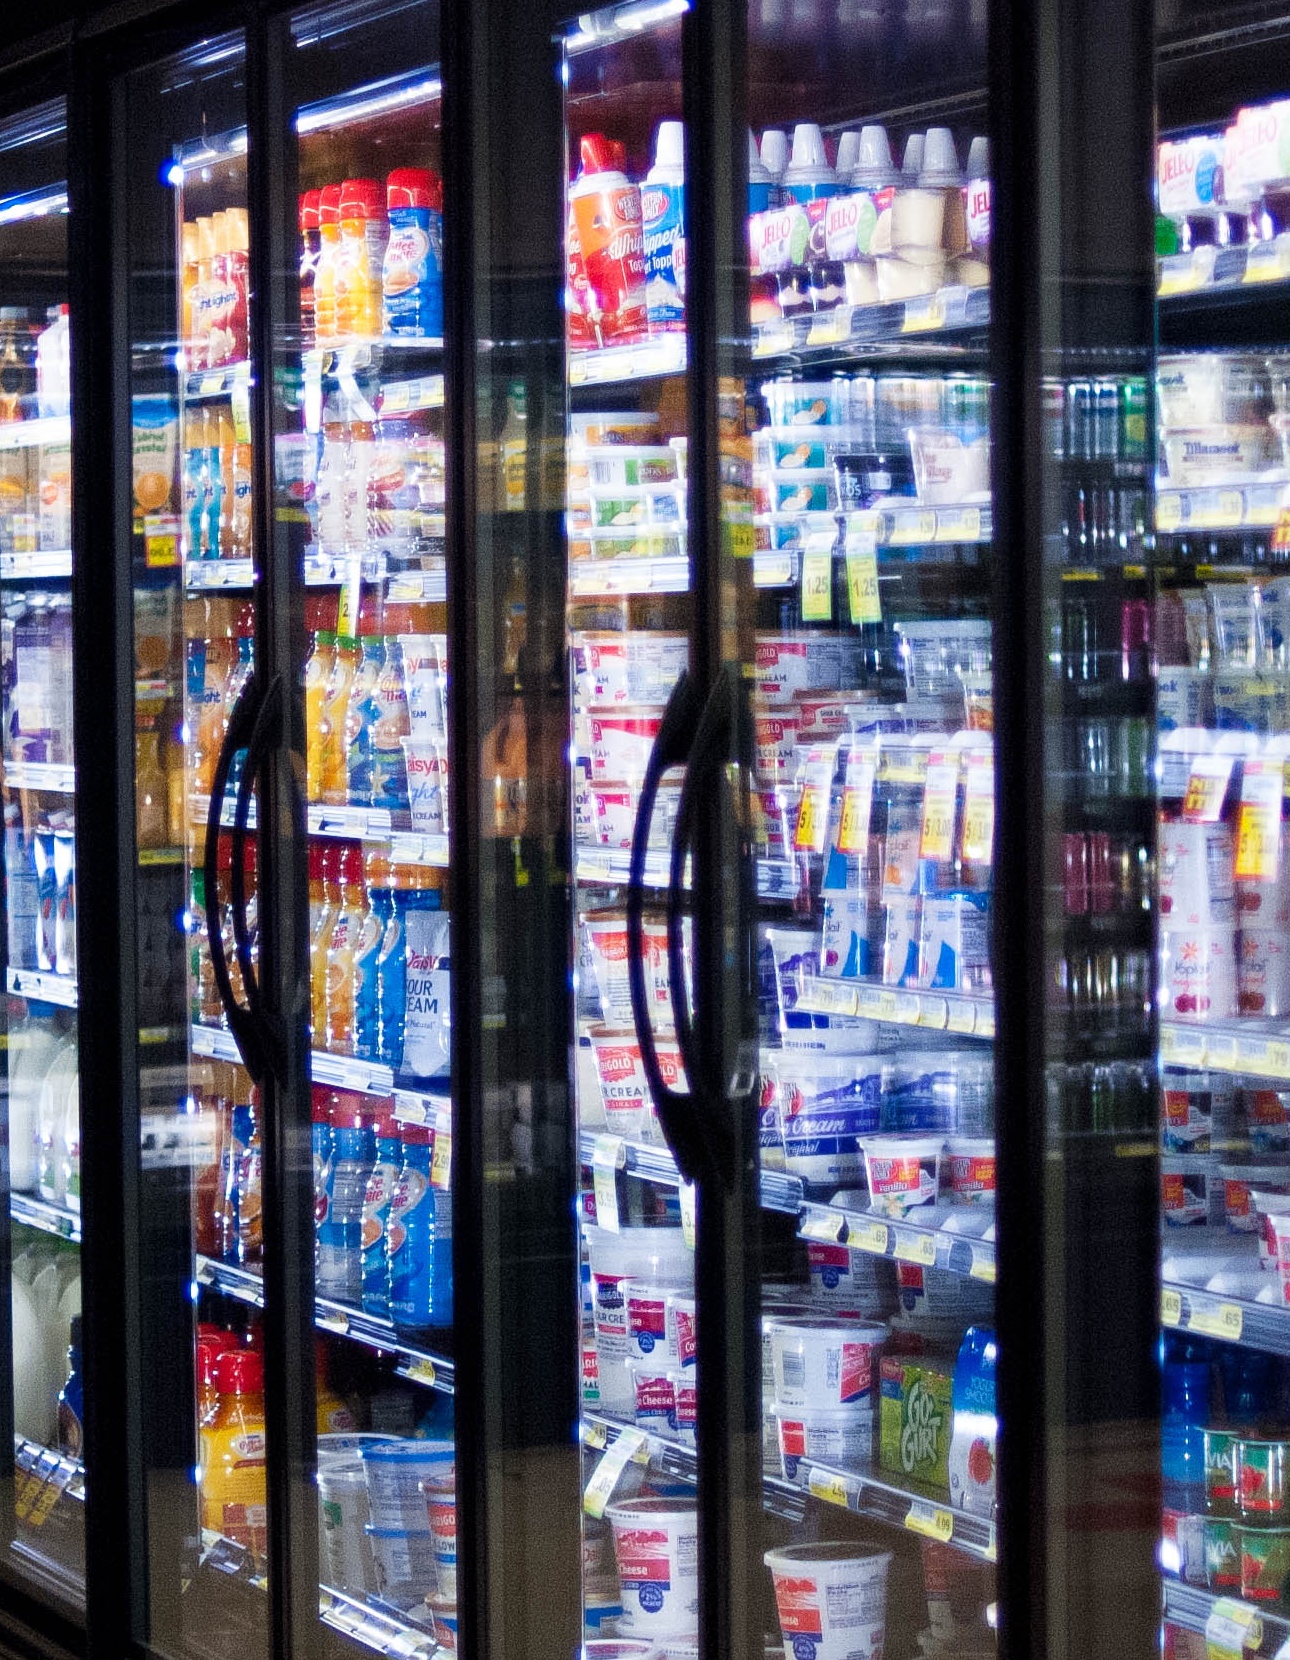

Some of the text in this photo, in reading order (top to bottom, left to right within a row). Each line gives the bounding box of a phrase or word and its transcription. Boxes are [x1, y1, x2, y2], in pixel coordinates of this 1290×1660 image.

[970, 191, 991, 220] JEL
[827, 202, 858, 237] JELL-O
[805, 576, 829, 598] 1.25
[407, 978, 434, 996] OUR
[407, 997, 439, 1015] EAM
